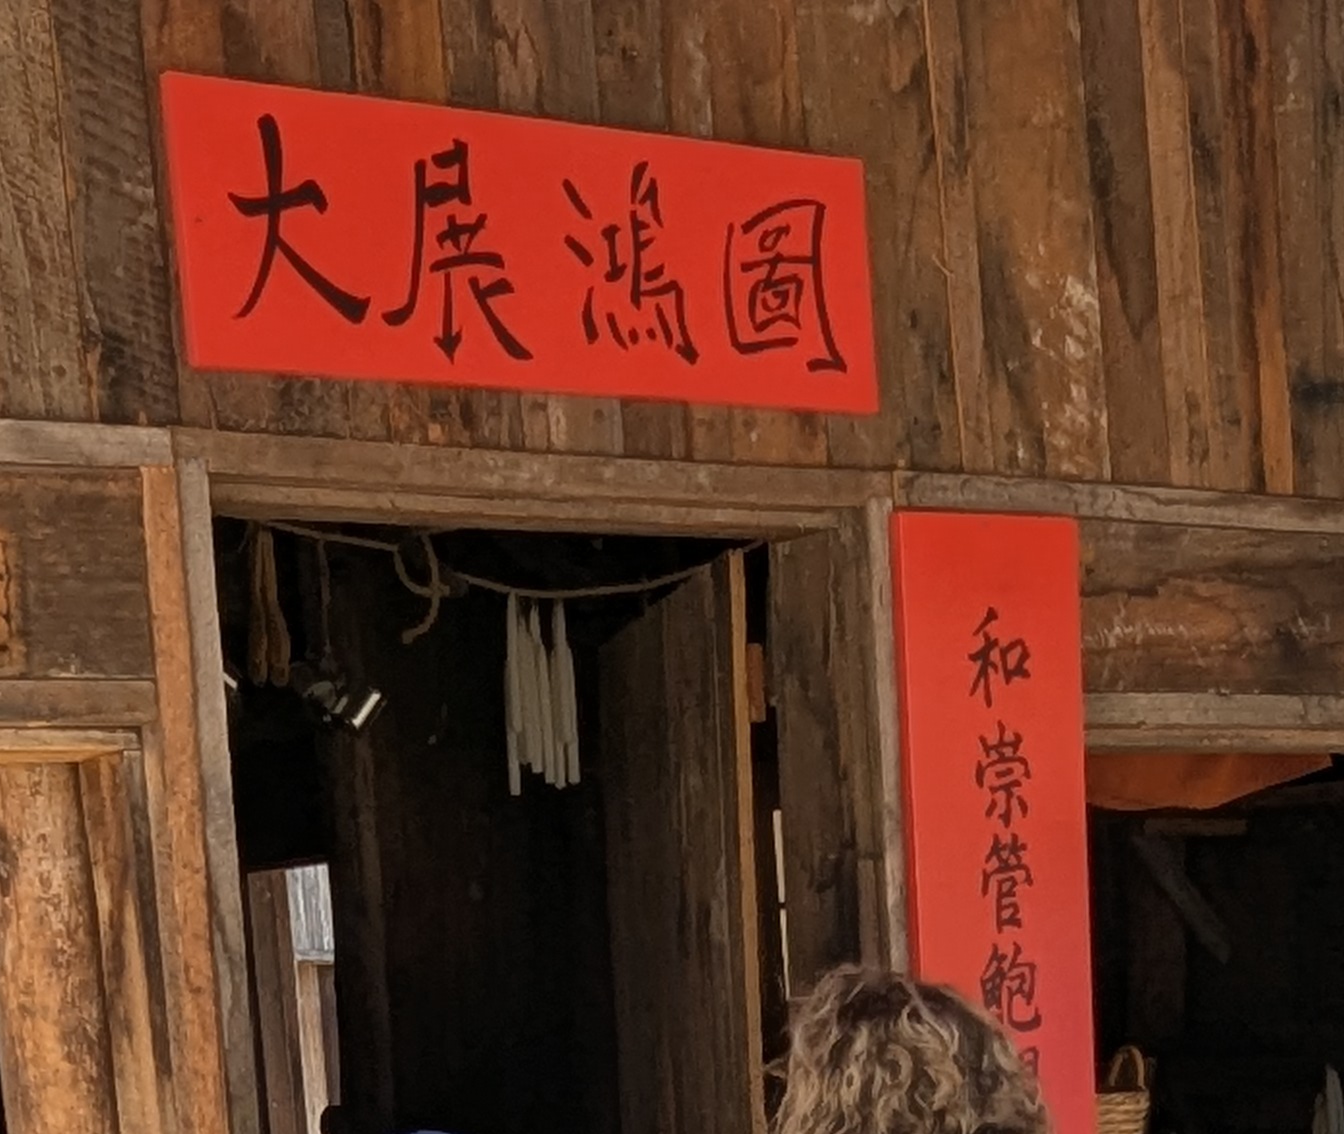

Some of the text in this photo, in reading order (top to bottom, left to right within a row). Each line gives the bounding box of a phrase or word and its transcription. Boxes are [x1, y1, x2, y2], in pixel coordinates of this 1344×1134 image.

[226, 113, 848, 372] 大展鴻圖
[968, 606, 1043, 1078] 和崇管鮑
